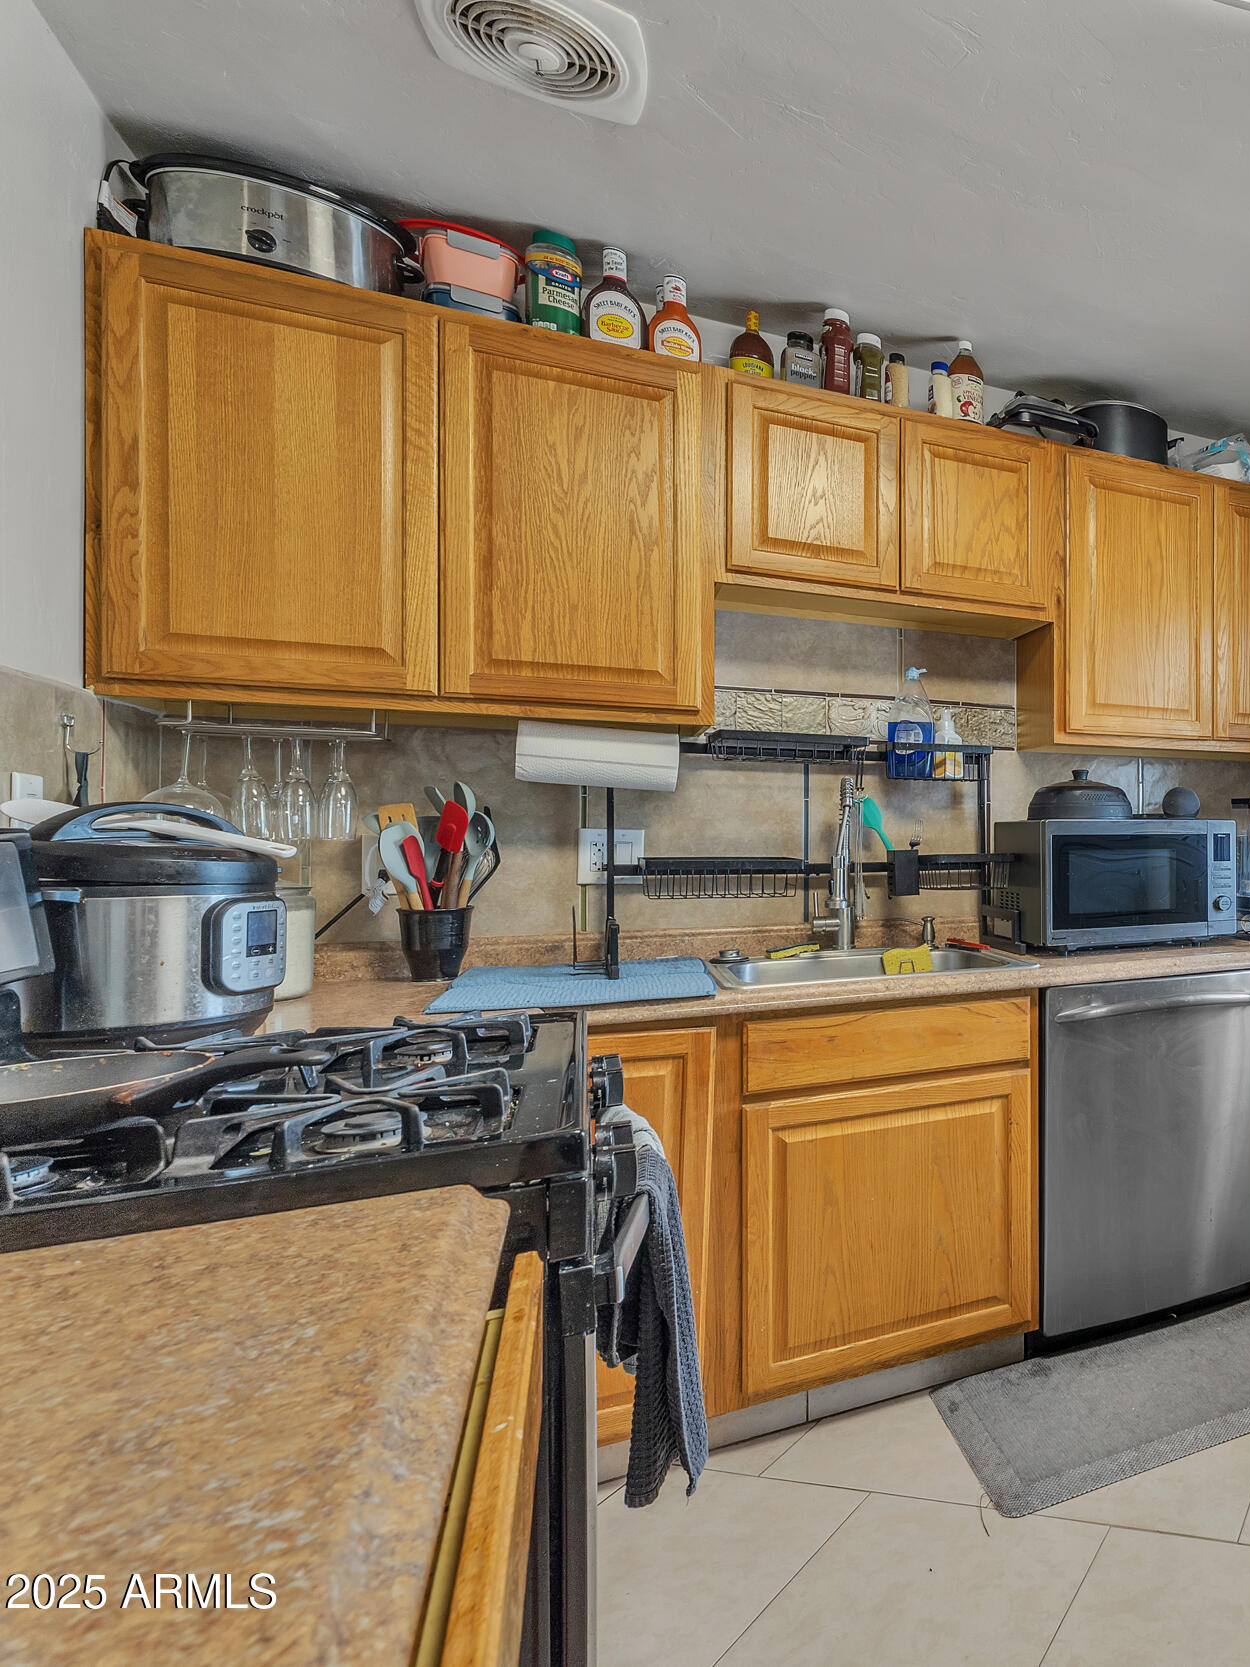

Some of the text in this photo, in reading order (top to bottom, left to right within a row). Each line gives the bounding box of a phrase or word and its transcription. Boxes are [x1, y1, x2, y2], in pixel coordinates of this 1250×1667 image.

[555, 270, 569, 279] Kraft
[542, 287, 578, 304] Parmesan
[548, 296, 575, 310] Cheese
[593, 300, 610, 309] SWEET
[624, 305, 637, 319] RAY'S
[600, 320, 630, 331] Barbecue
[790, 370, 817, 380] pepper
[791, 363, 817, 376] black
